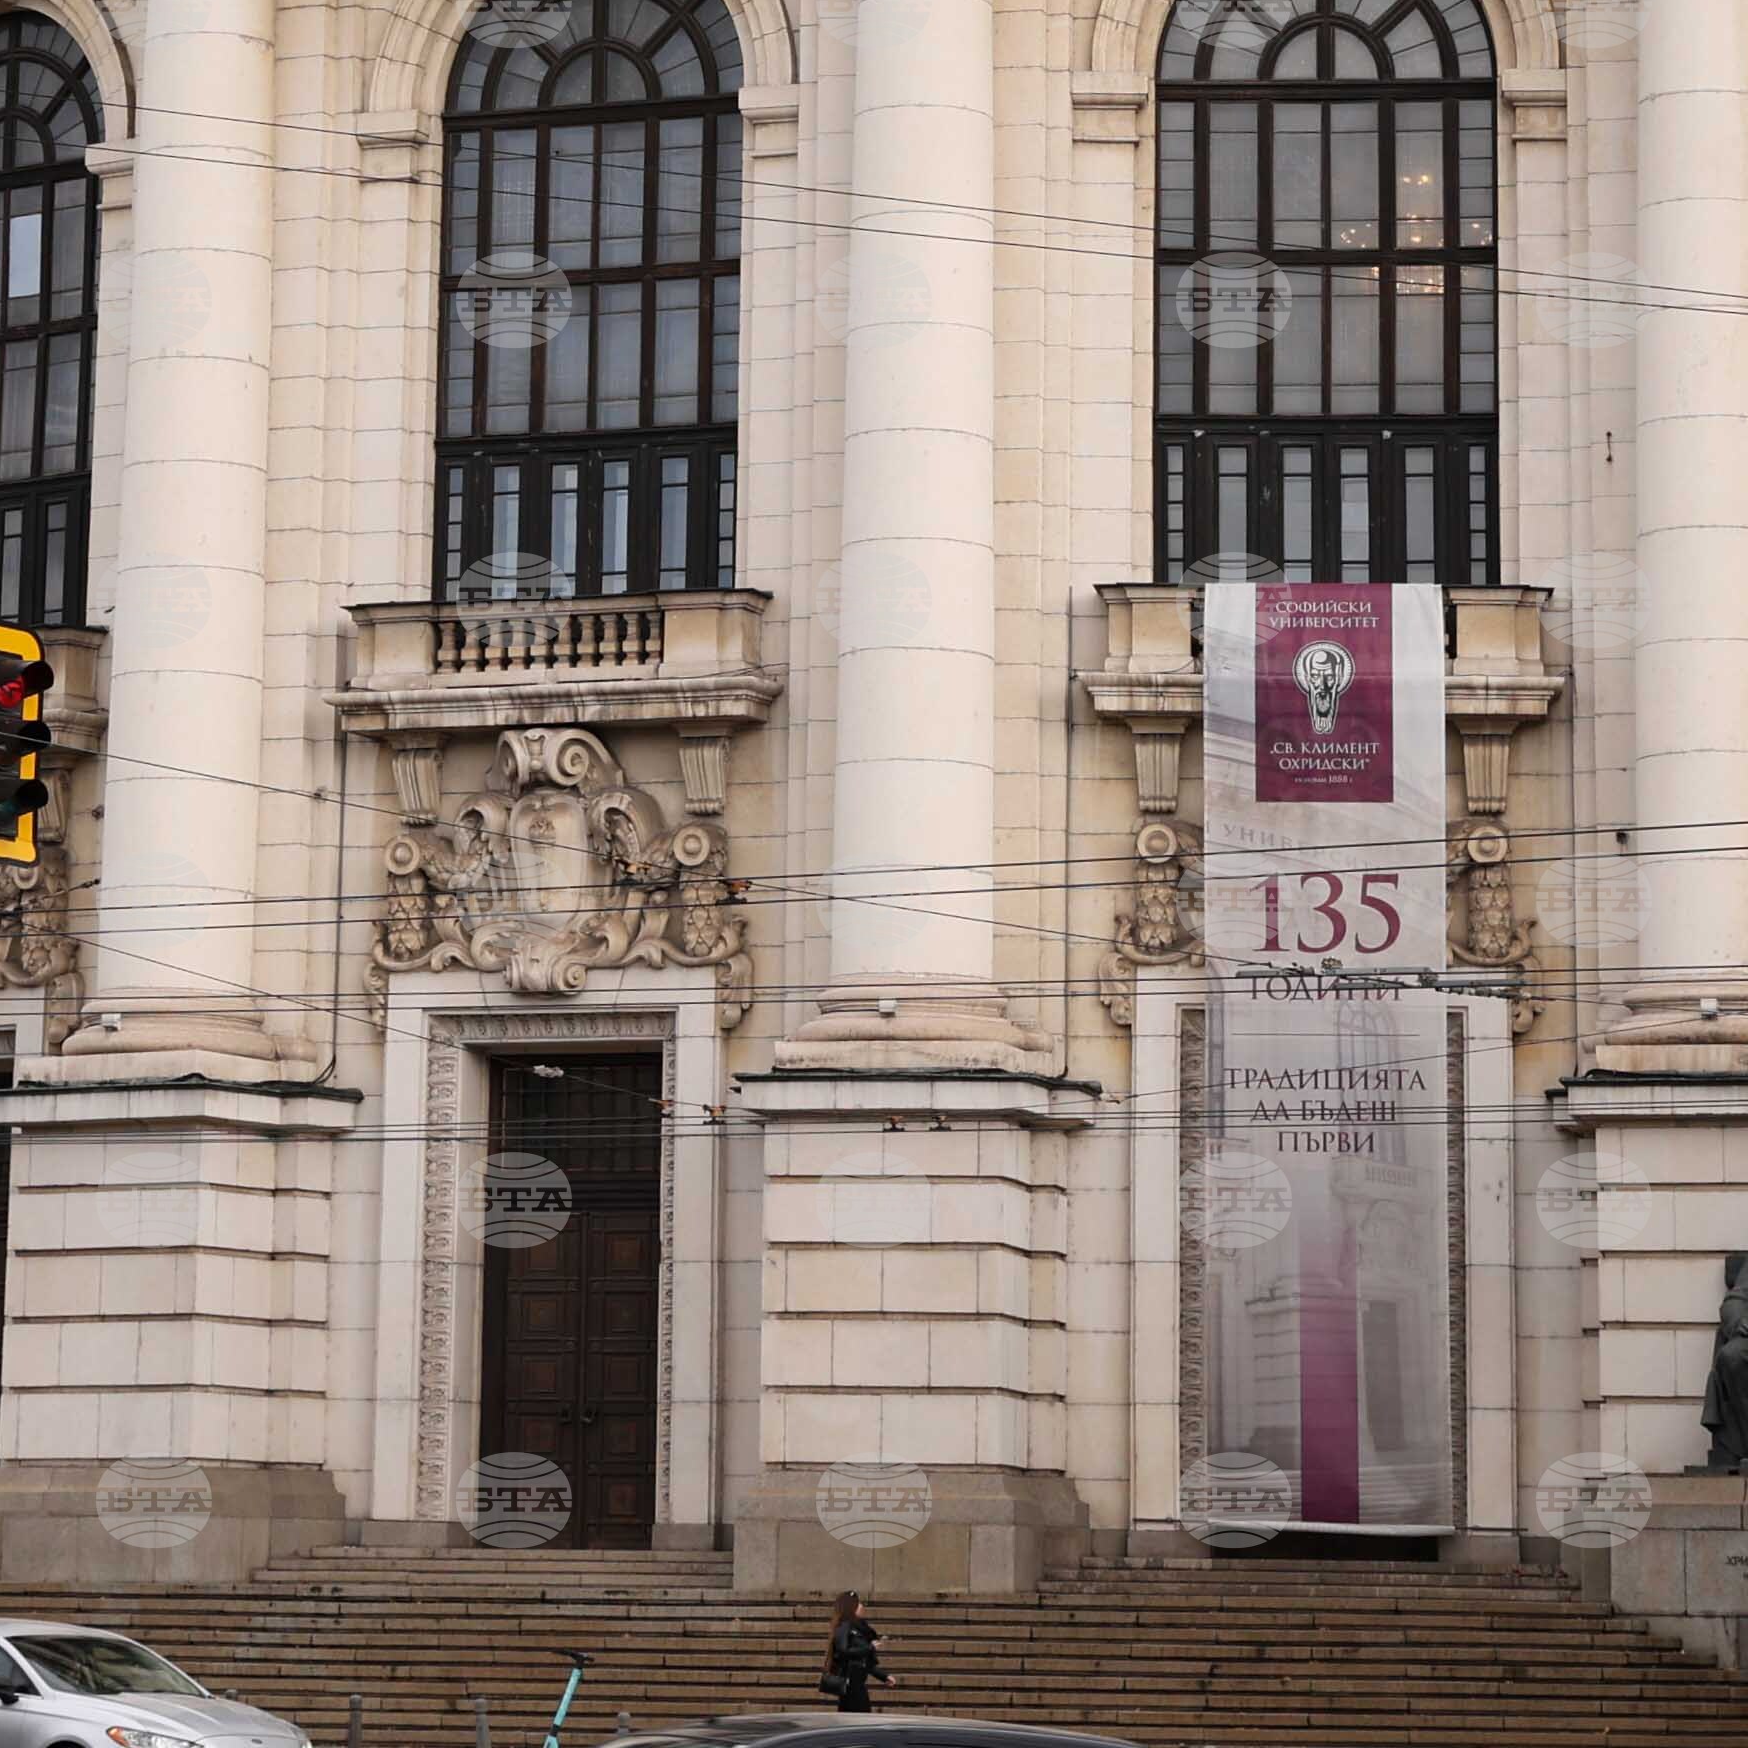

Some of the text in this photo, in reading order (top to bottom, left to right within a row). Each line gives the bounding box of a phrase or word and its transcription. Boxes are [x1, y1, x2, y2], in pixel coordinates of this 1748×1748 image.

[1275, 599, 1372, 614] СОФИЙСКИ
[1269, 616, 1380, 629] УНИВЕРСИТЕТ
[1301, 742, 1380, 754] КЛИМЕНТ
[1249, 872, 1402, 954] 135
[1224, 1068, 1427, 1092] ТРАДИЦИЯТА
[1250, 1099, 1397, 1124] ДА БЪДЕШ
[1277, 1131, 1375, 1153] ПЪРВИ
